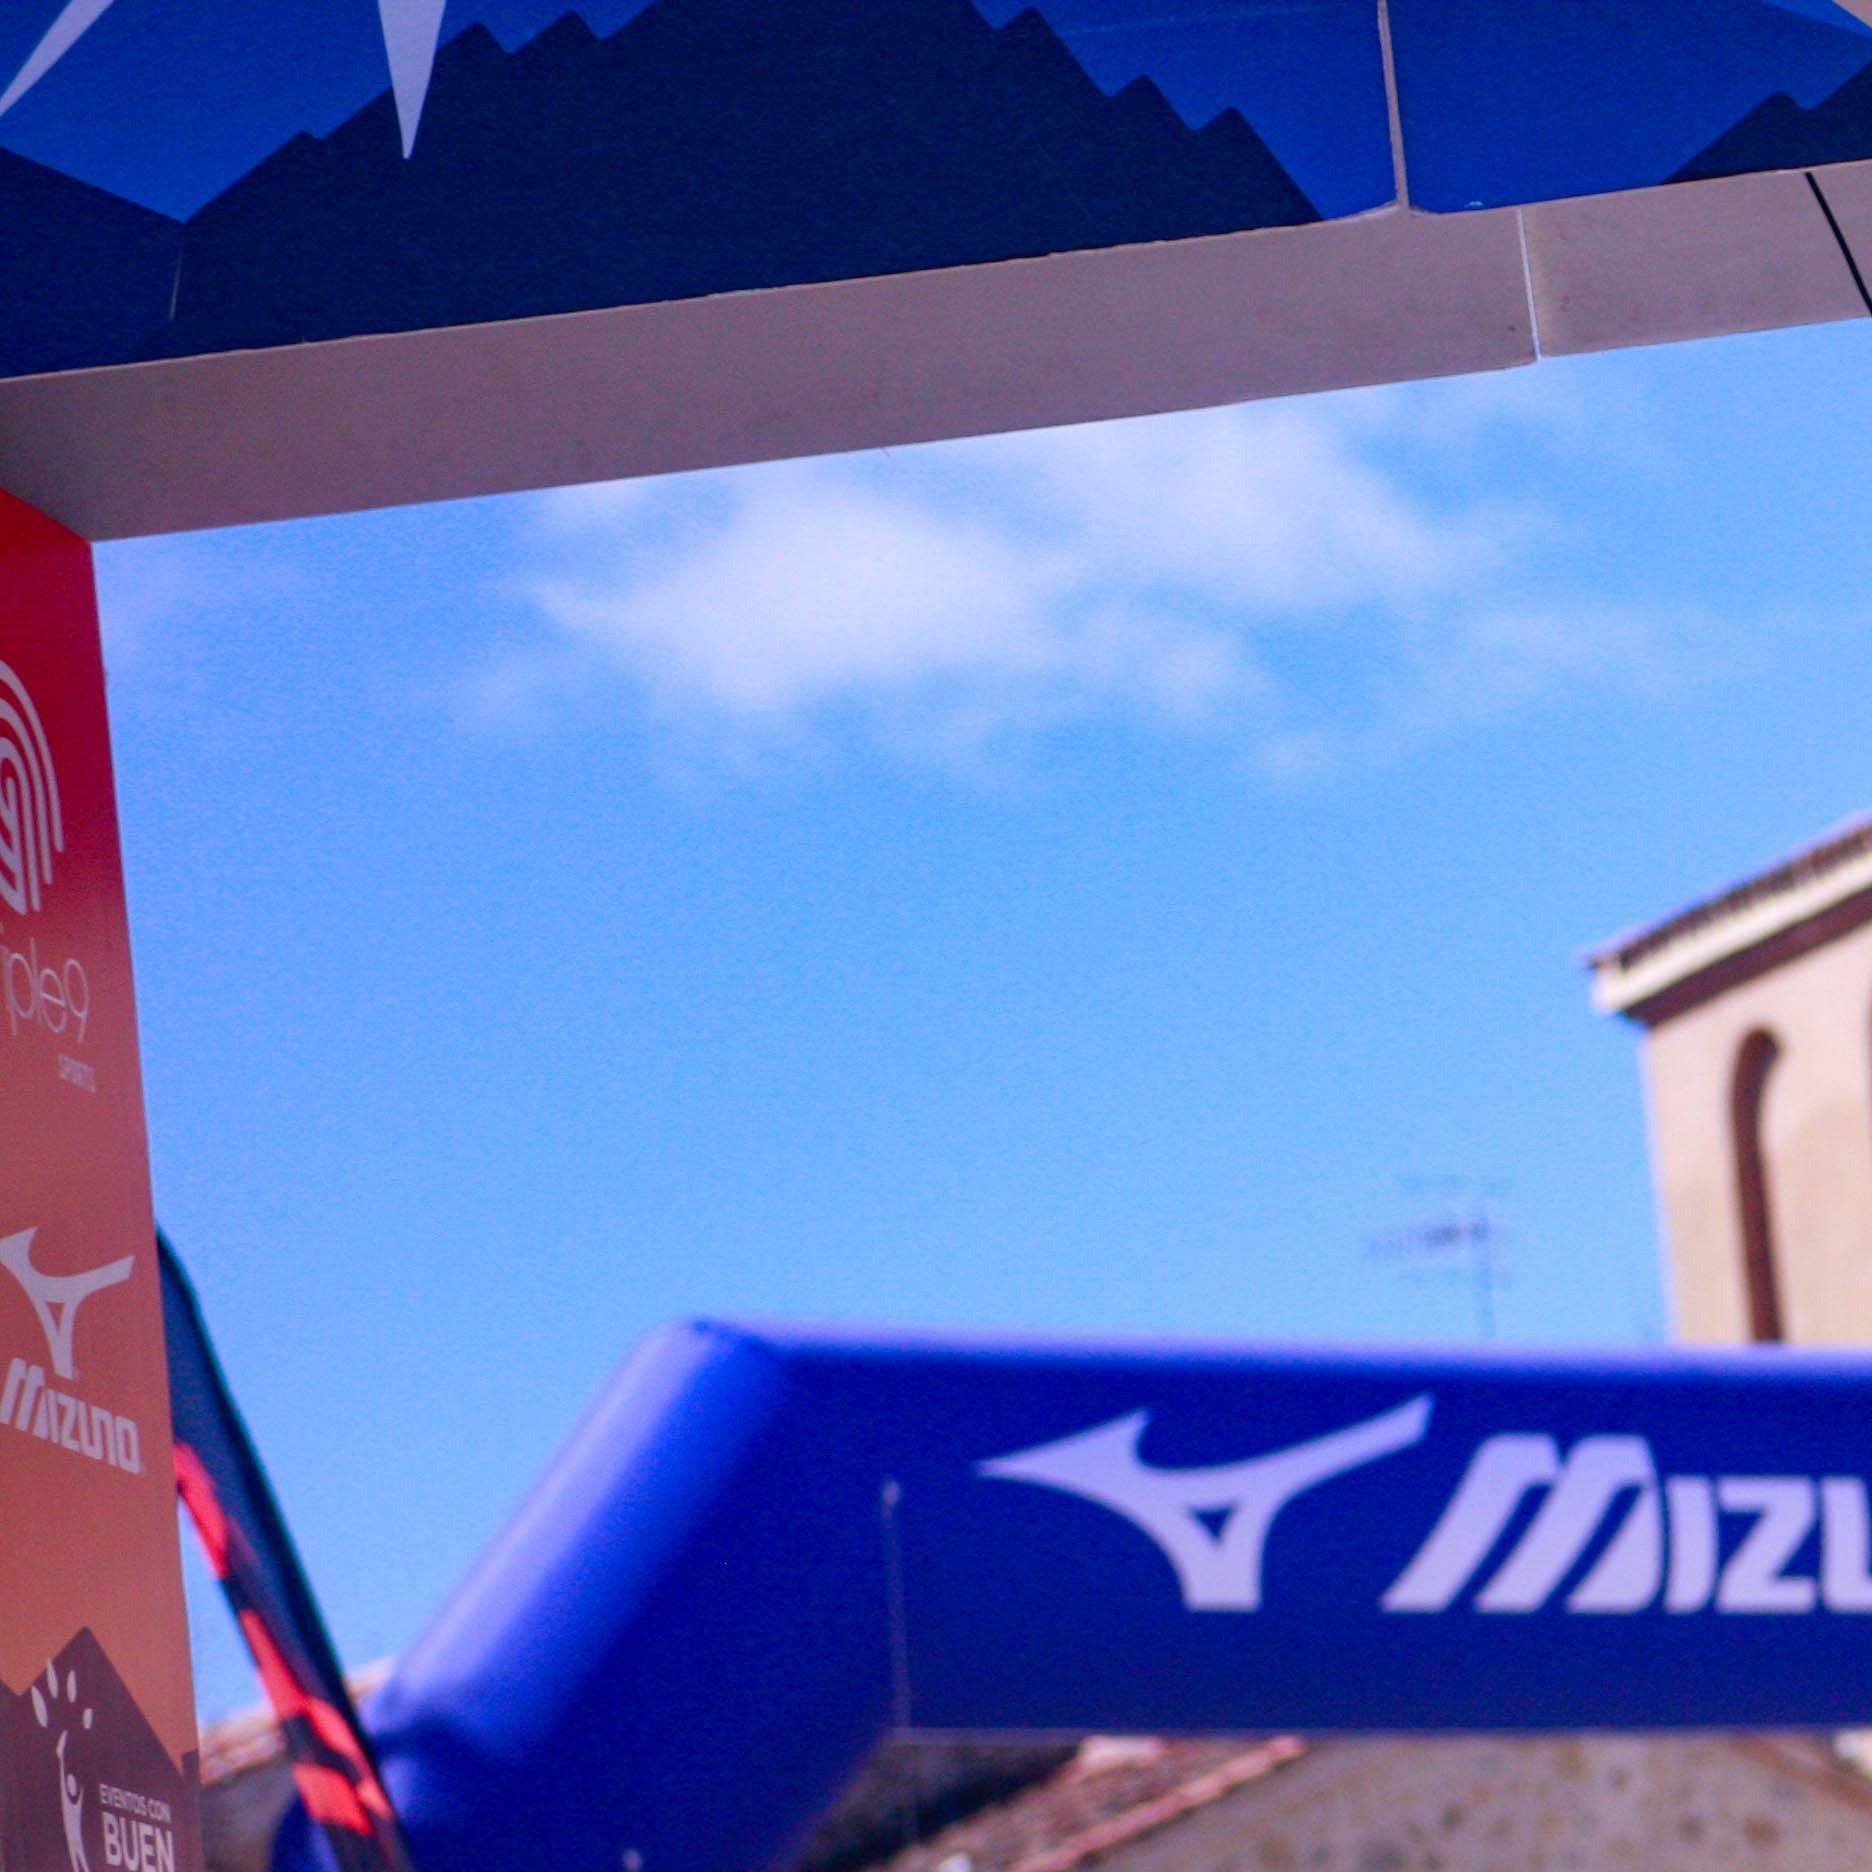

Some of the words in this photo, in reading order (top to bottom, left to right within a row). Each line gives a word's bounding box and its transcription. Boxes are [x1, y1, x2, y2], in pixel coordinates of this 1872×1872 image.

[2, 936, 91, 1043] ple9
[101, 1782, 147, 1818] EVENTOS
[148, 1797, 172, 1824] CON
